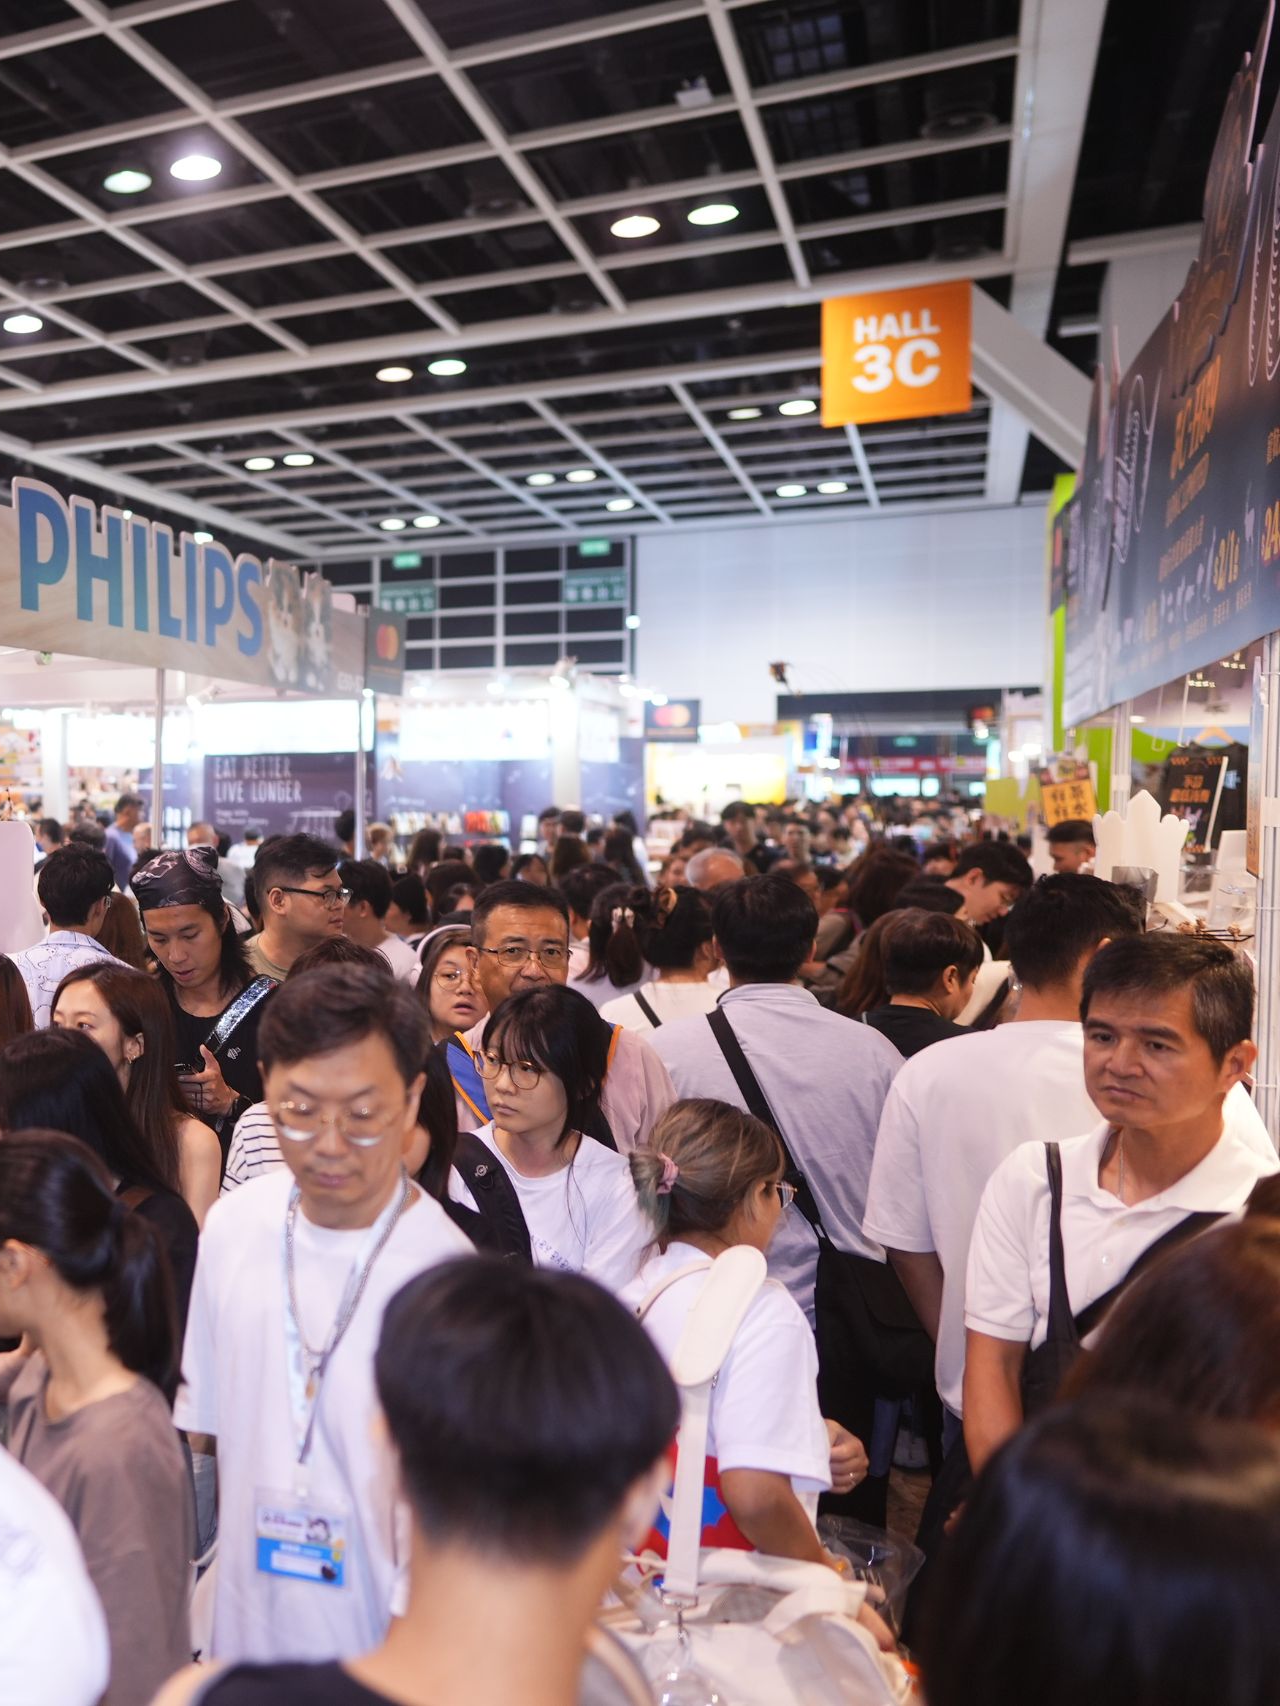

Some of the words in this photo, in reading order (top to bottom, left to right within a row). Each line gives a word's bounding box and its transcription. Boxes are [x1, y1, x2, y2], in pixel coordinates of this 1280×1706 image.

[853, 308, 940, 344] HALL
[851, 340, 941, 393] 3C
[17, 486, 264, 657] PHILIPS
[215, 757, 237, 779] EAT
[244, 756, 291, 779] BETTER
[215, 780, 244, 803] LIVE
[252, 780, 302, 803] LONGER
